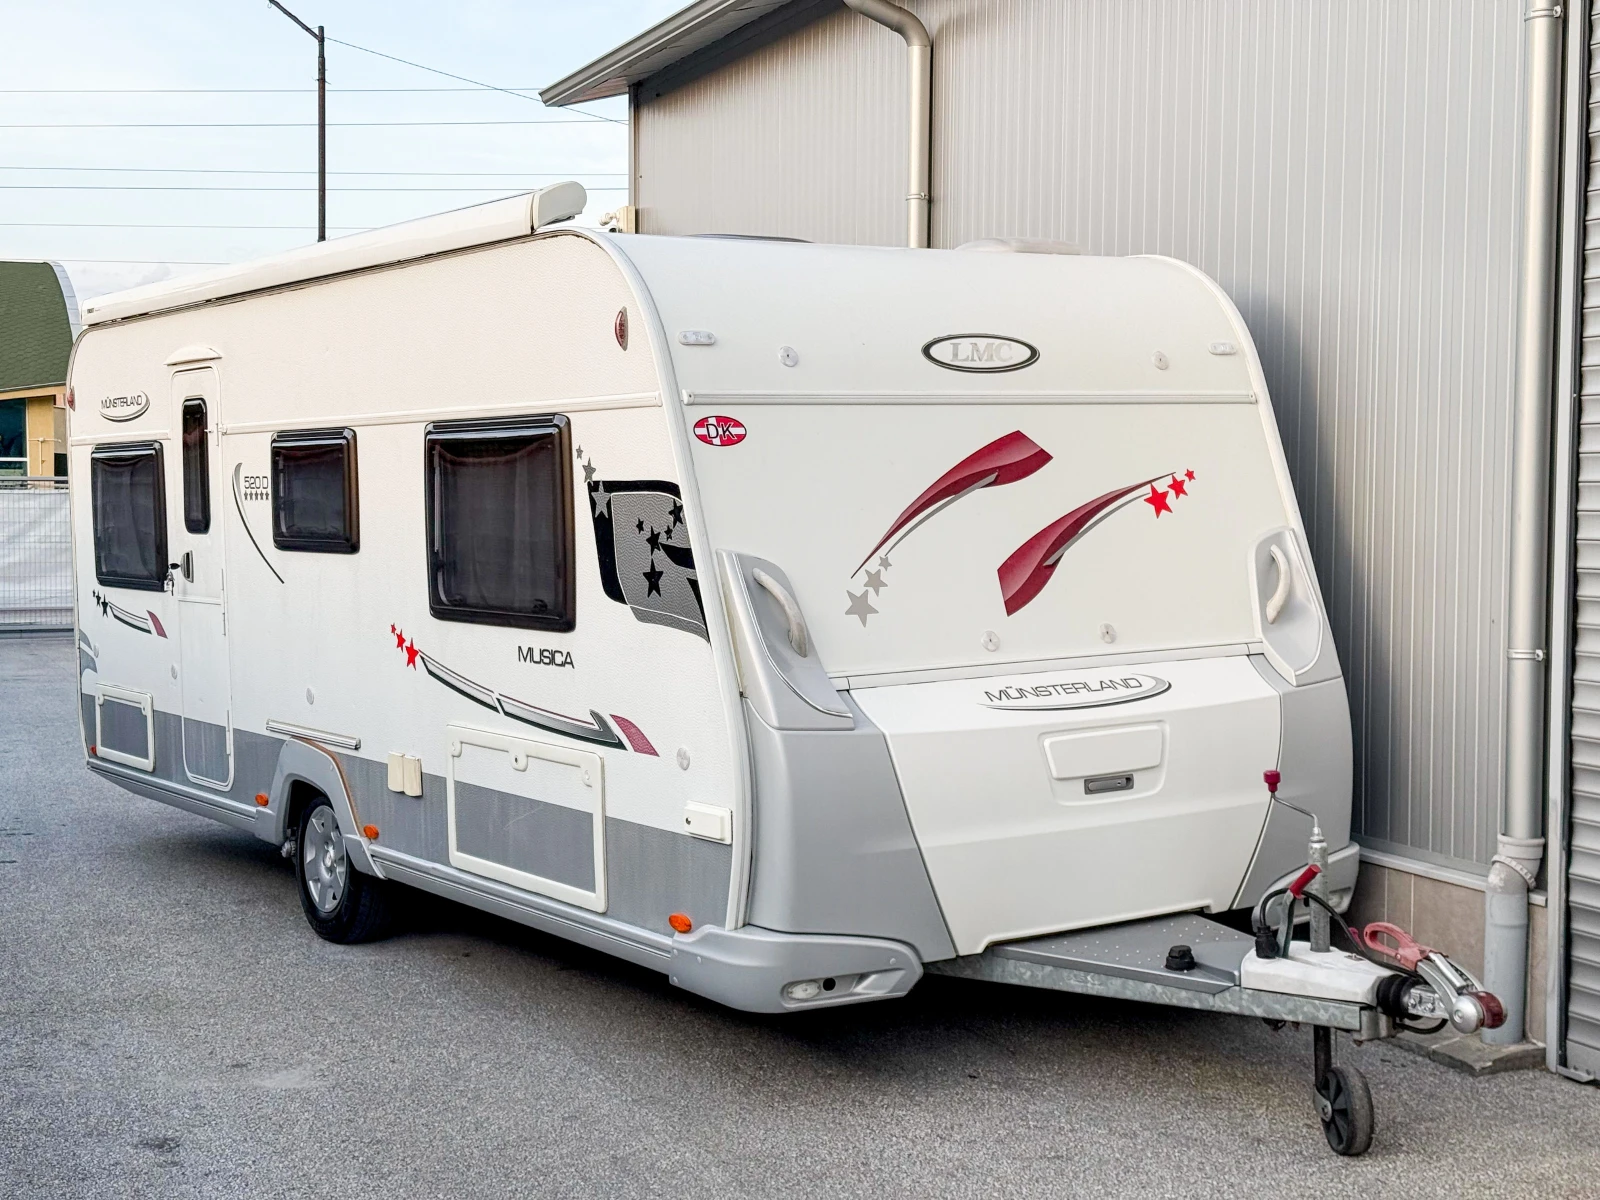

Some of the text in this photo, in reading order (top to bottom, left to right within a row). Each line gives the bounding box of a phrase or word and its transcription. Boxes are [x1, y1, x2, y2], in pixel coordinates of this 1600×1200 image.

[950, 342, 1013, 362] LMC
[101, 395, 143, 409] MÜNSTERLAND
[705, 422, 737, 440] DK
[518, 645, 575, 669] MUSICA
[984, 677, 1143, 703] MÜNSTERLAND
